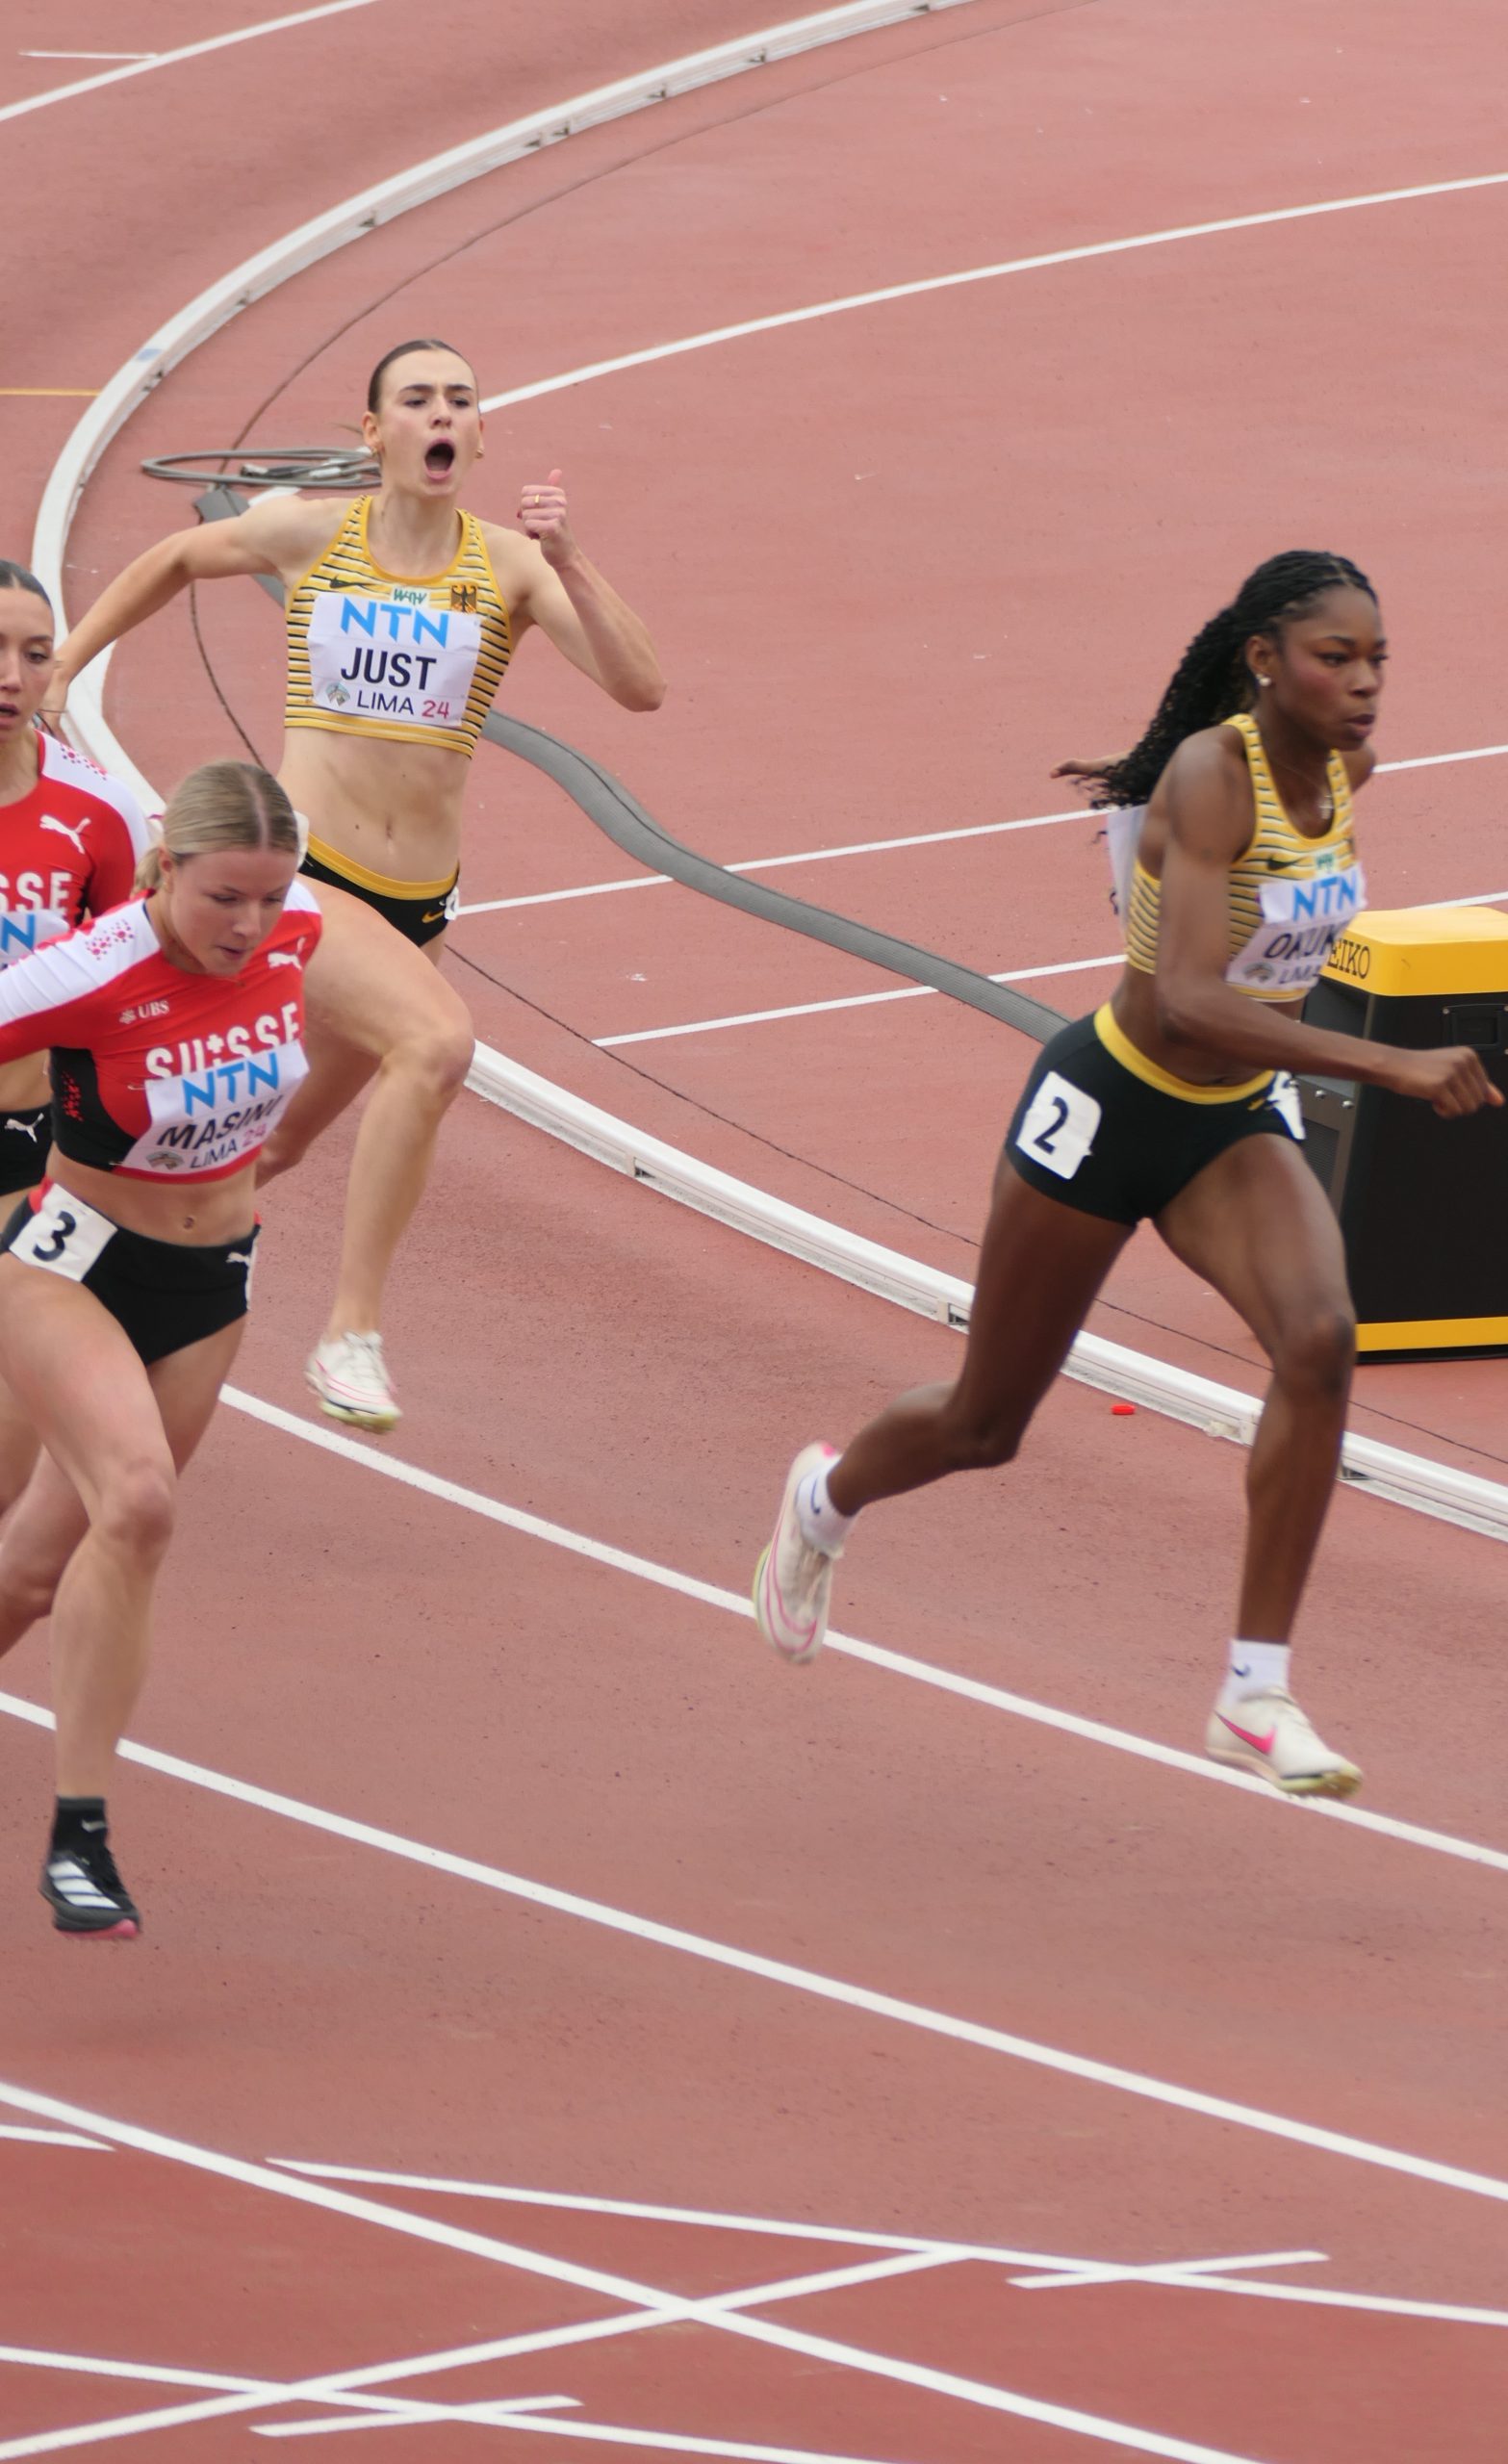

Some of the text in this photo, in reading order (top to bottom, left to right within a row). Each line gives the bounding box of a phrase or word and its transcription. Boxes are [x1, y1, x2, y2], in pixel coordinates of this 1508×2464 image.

[340, 597, 449, 649] NTN
[340, 647, 437, 691] JUST
[357, 690, 450, 719] LIMA 24
[1292, 869, 1357, 922] NTN
[1326, 937, 1371, 980] EIKO
[138, 1000, 171, 1019] UBS
[181, 1051, 280, 1117] NTN
[157, 1094, 285, 1150] MASINI
[189, 1123, 267, 1169] LIMA 24
[1033, 1095, 1069, 1155] 2
[32, 1210, 77, 1262] 3
